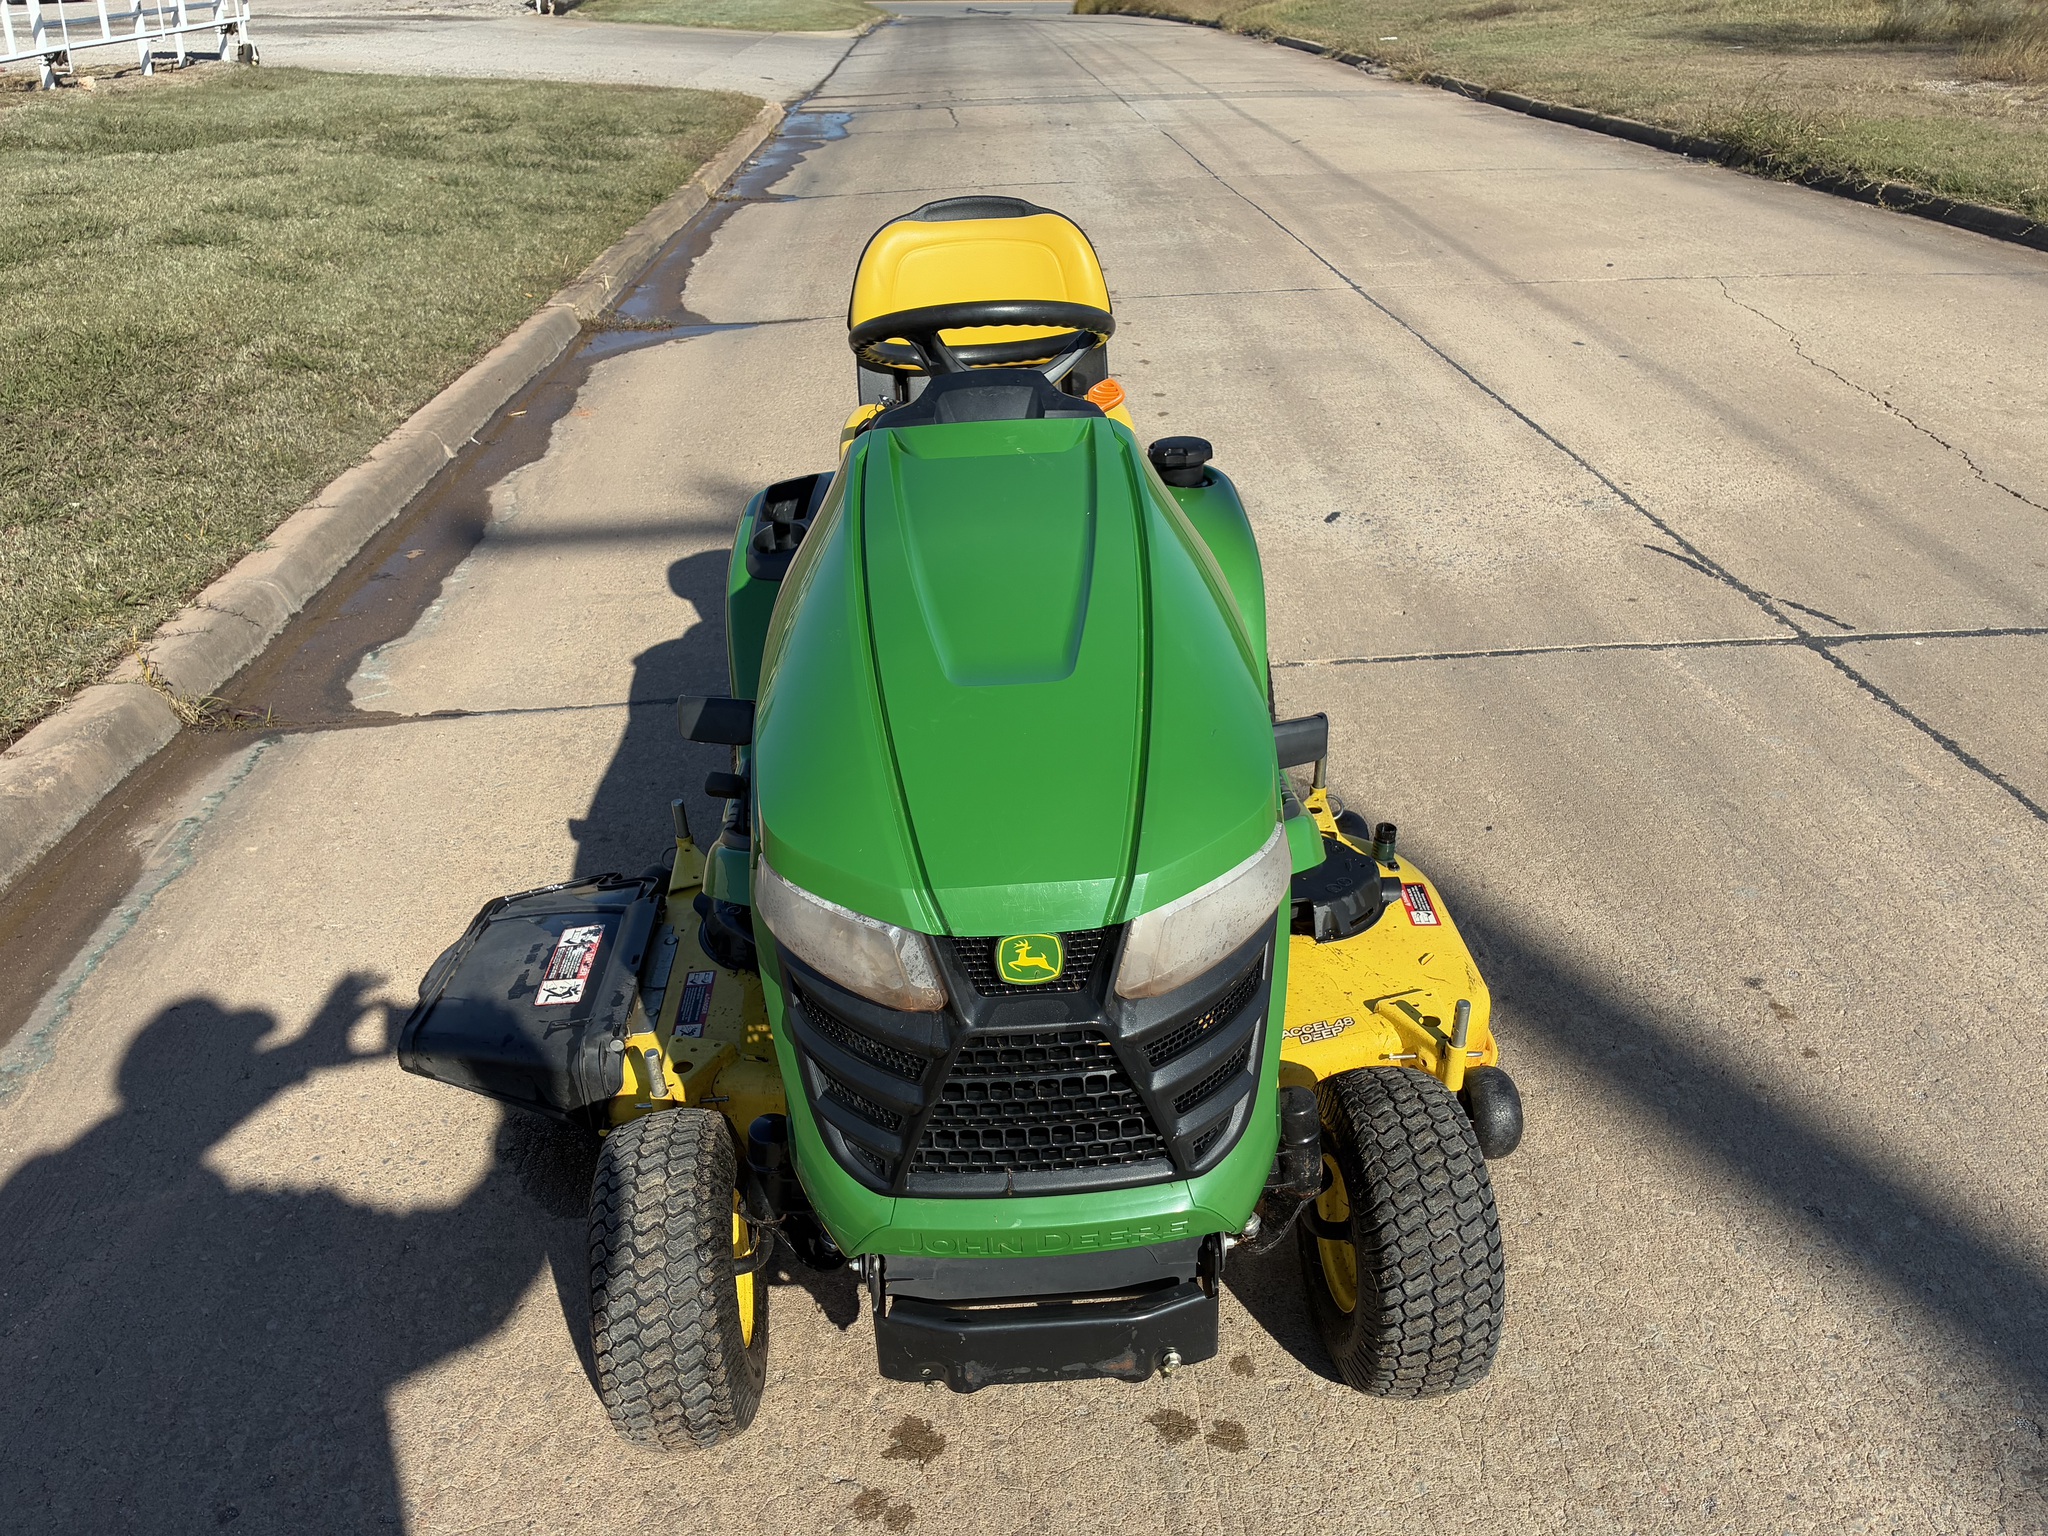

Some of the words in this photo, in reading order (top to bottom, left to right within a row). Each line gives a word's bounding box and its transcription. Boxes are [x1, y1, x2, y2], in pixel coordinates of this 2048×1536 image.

[1300, 1026, 1344, 1045] DEEP
[899, 1232, 1023, 1254] JOHN
[1036, 1218, 1190, 1253] DEERE
